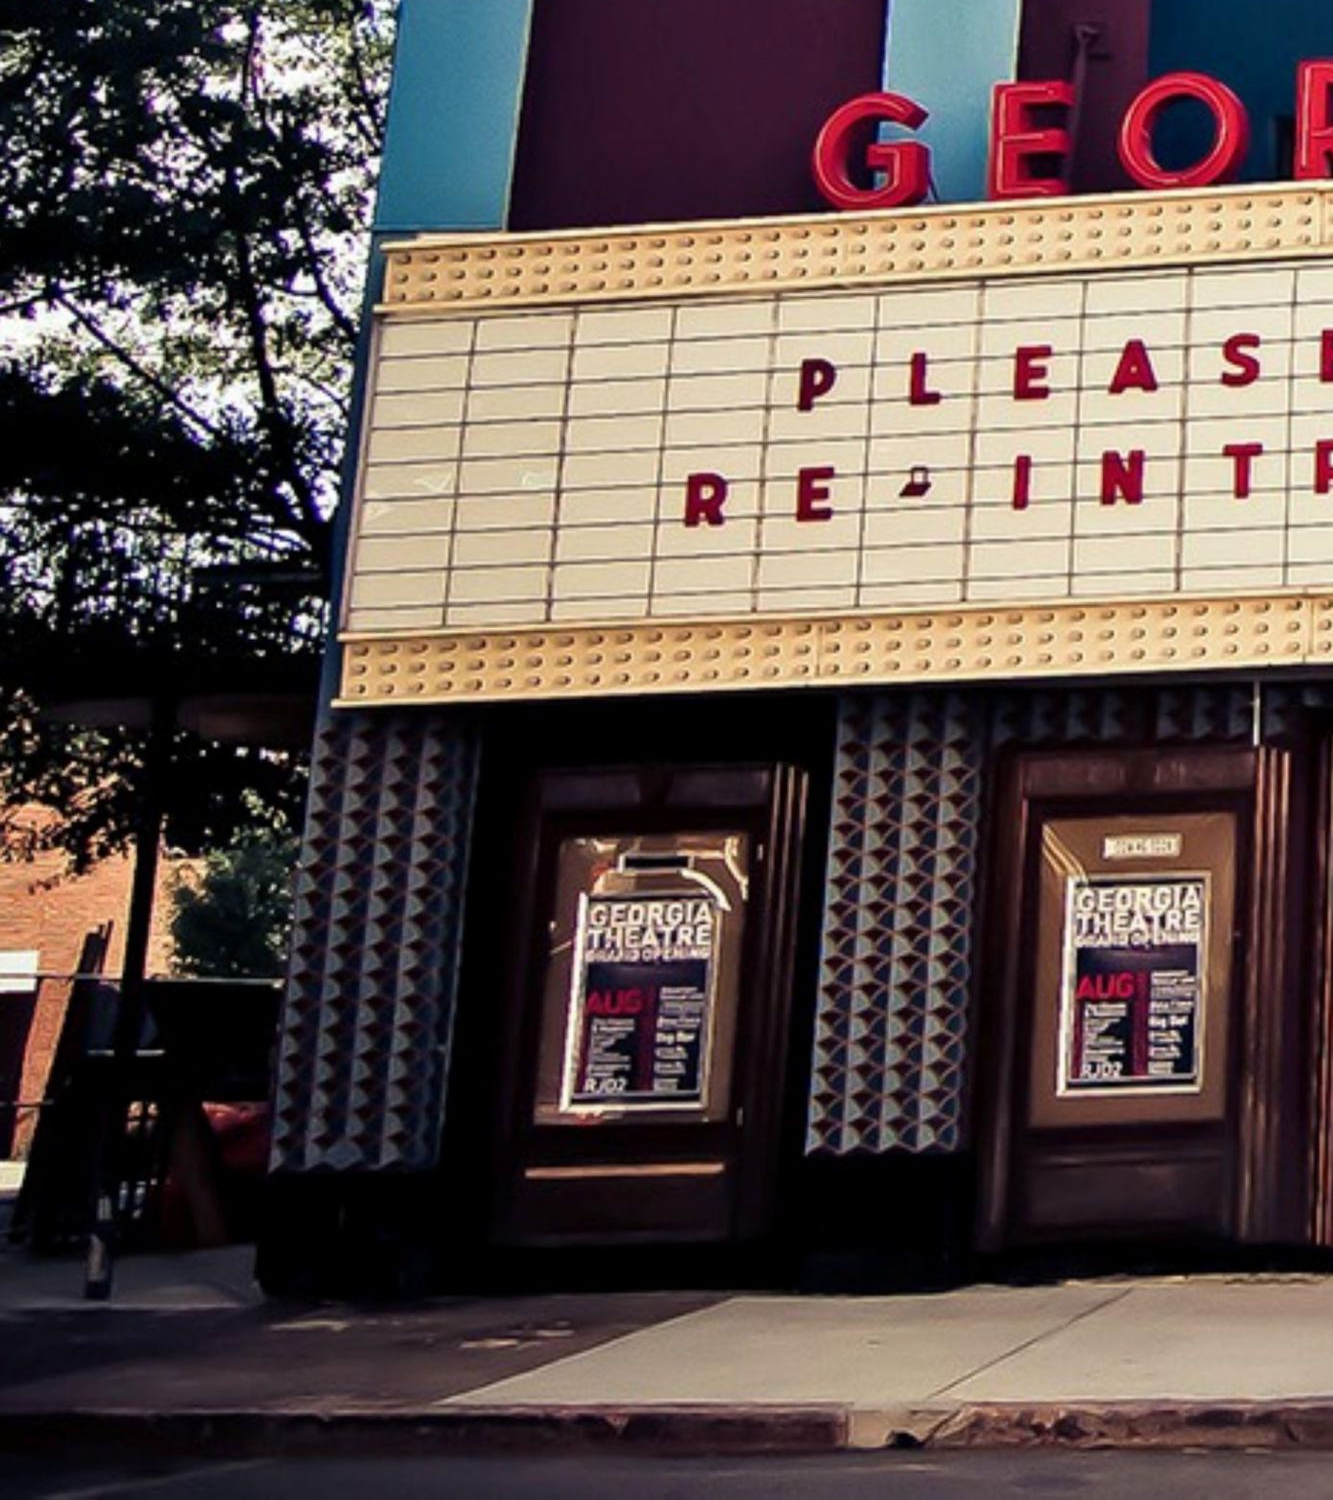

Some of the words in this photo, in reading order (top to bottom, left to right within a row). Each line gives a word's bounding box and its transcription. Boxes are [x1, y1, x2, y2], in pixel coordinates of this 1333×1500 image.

[1078, 885, 1200, 911] GEORGIA
[590, 901, 713, 926] GEORGIA
[1076, 909, 1199, 934] THEATRE
[587, 925, 712, 949] THEATRE
[1078, 972, 1133, 999] AUG
[587, 989, 642, 1014] AUG
